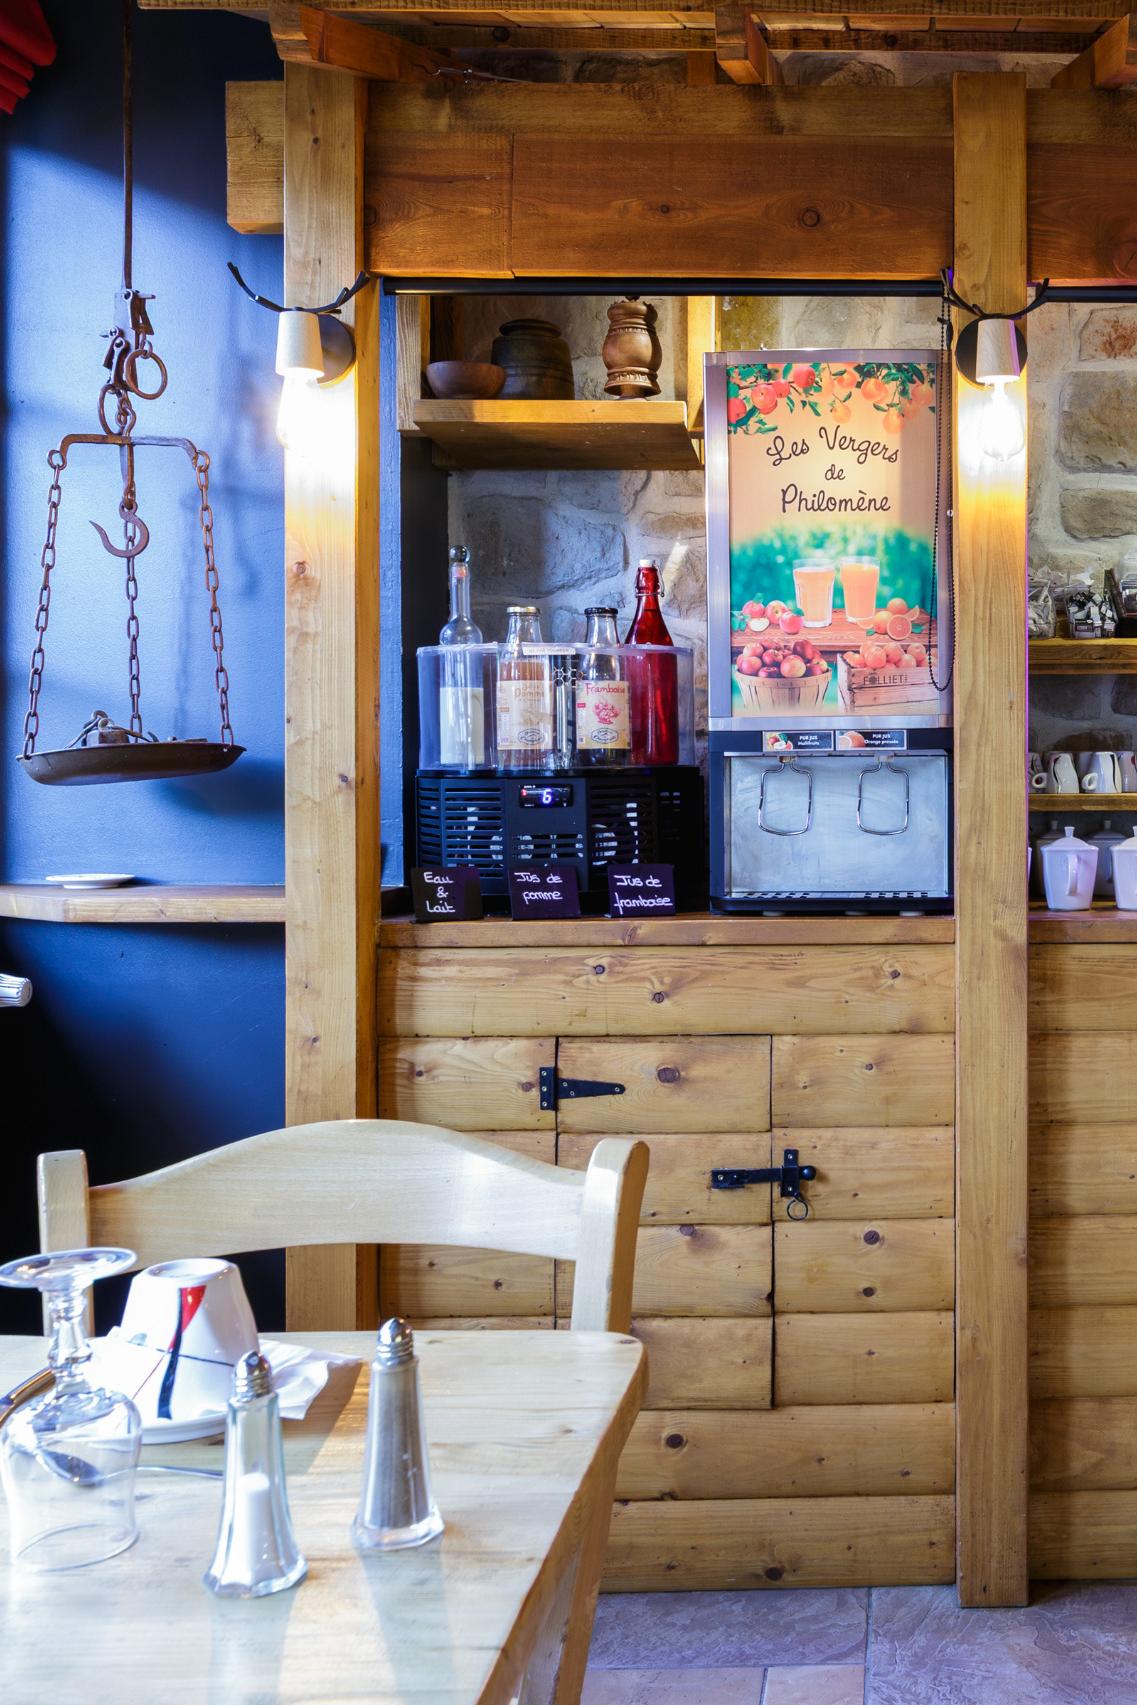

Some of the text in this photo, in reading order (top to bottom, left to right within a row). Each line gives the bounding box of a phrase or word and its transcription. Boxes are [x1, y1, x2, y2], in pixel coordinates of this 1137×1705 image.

[766, 424, 899, 467] Les Vergers
[824, 463, 846, 481] de
[781, 483, 891, 513] Philomène
[542, 788, 552, 804] 6
[424, 871, 454, 884] Eau
[514, 872, 563, 883] Jus de
[613, 874, 662, 887] Jus de
[437, 886, 449, 898] &
[522, 891, 563, 904] pomme
[613, 892, 674, 914] framboise
